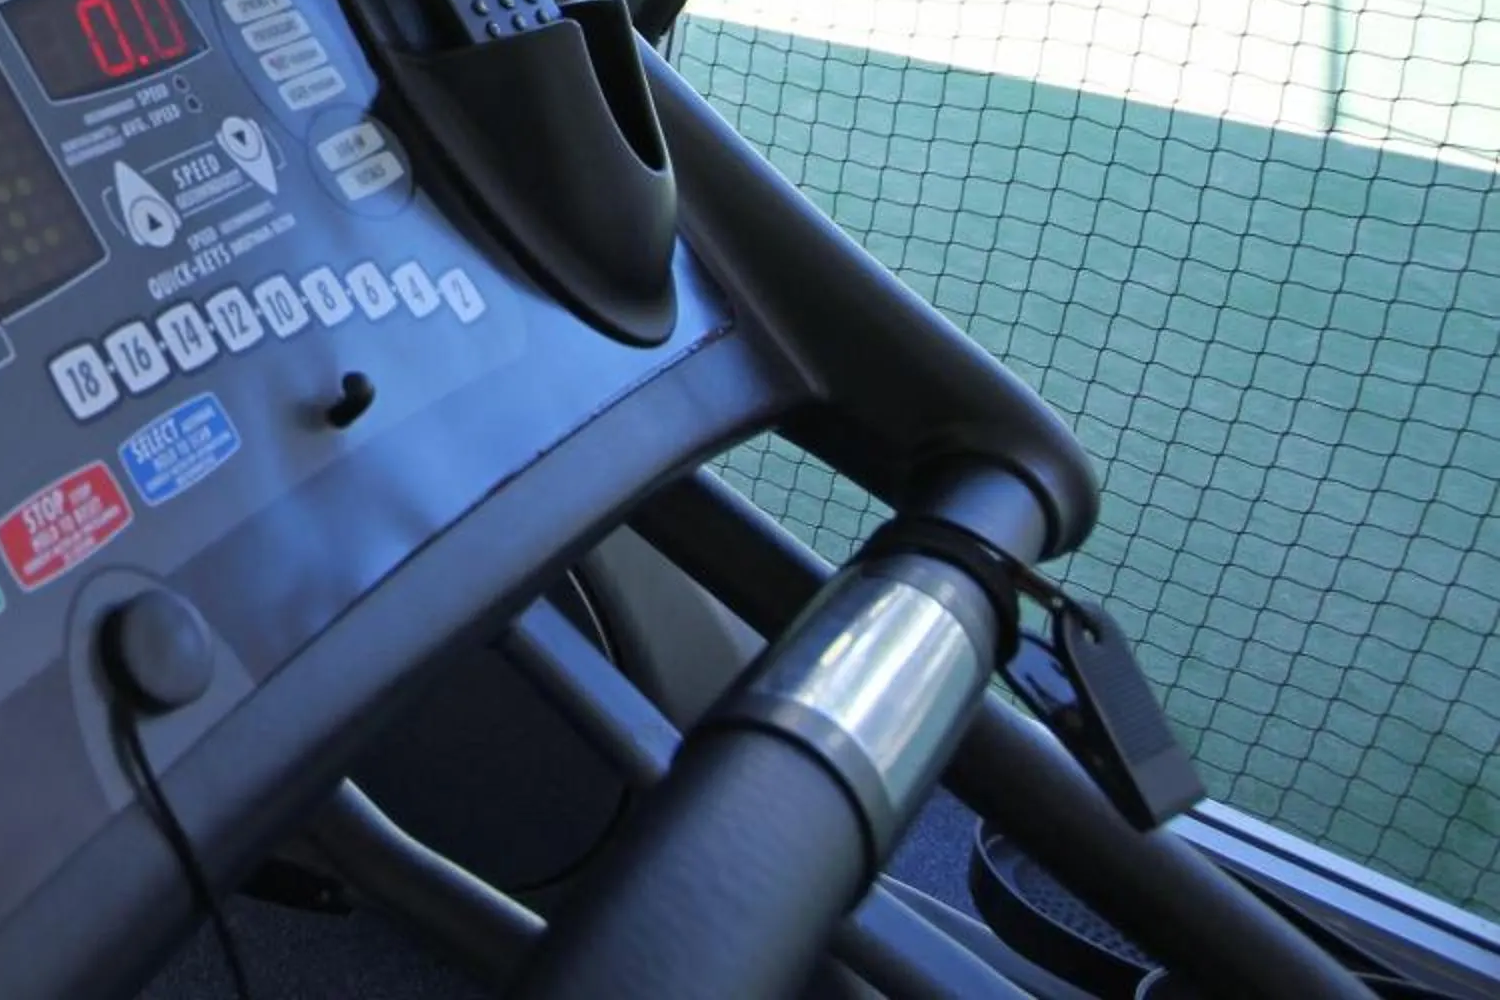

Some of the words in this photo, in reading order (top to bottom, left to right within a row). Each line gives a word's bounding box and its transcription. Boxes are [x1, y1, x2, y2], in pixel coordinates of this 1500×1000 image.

[172, 154, 221, 189] SPEED
[148, 243, 231, 300] QUICK-KEYS
[361, 275, 380, 305] 6
[408, 275, 427, 303] 4
[267, 290, 294, 326] 10
[317, 279, 337, 310] 8
[451, 277, 472, 309] 2
[171, 315, 202, 356] 14
[218, 301, 248, 339] 12
[119, 336, 152, 378] 16
[66, 360, 101, 403] 18
[129, 418, 179, 464] SELECT
[22, 490, 63, 534] STOP
